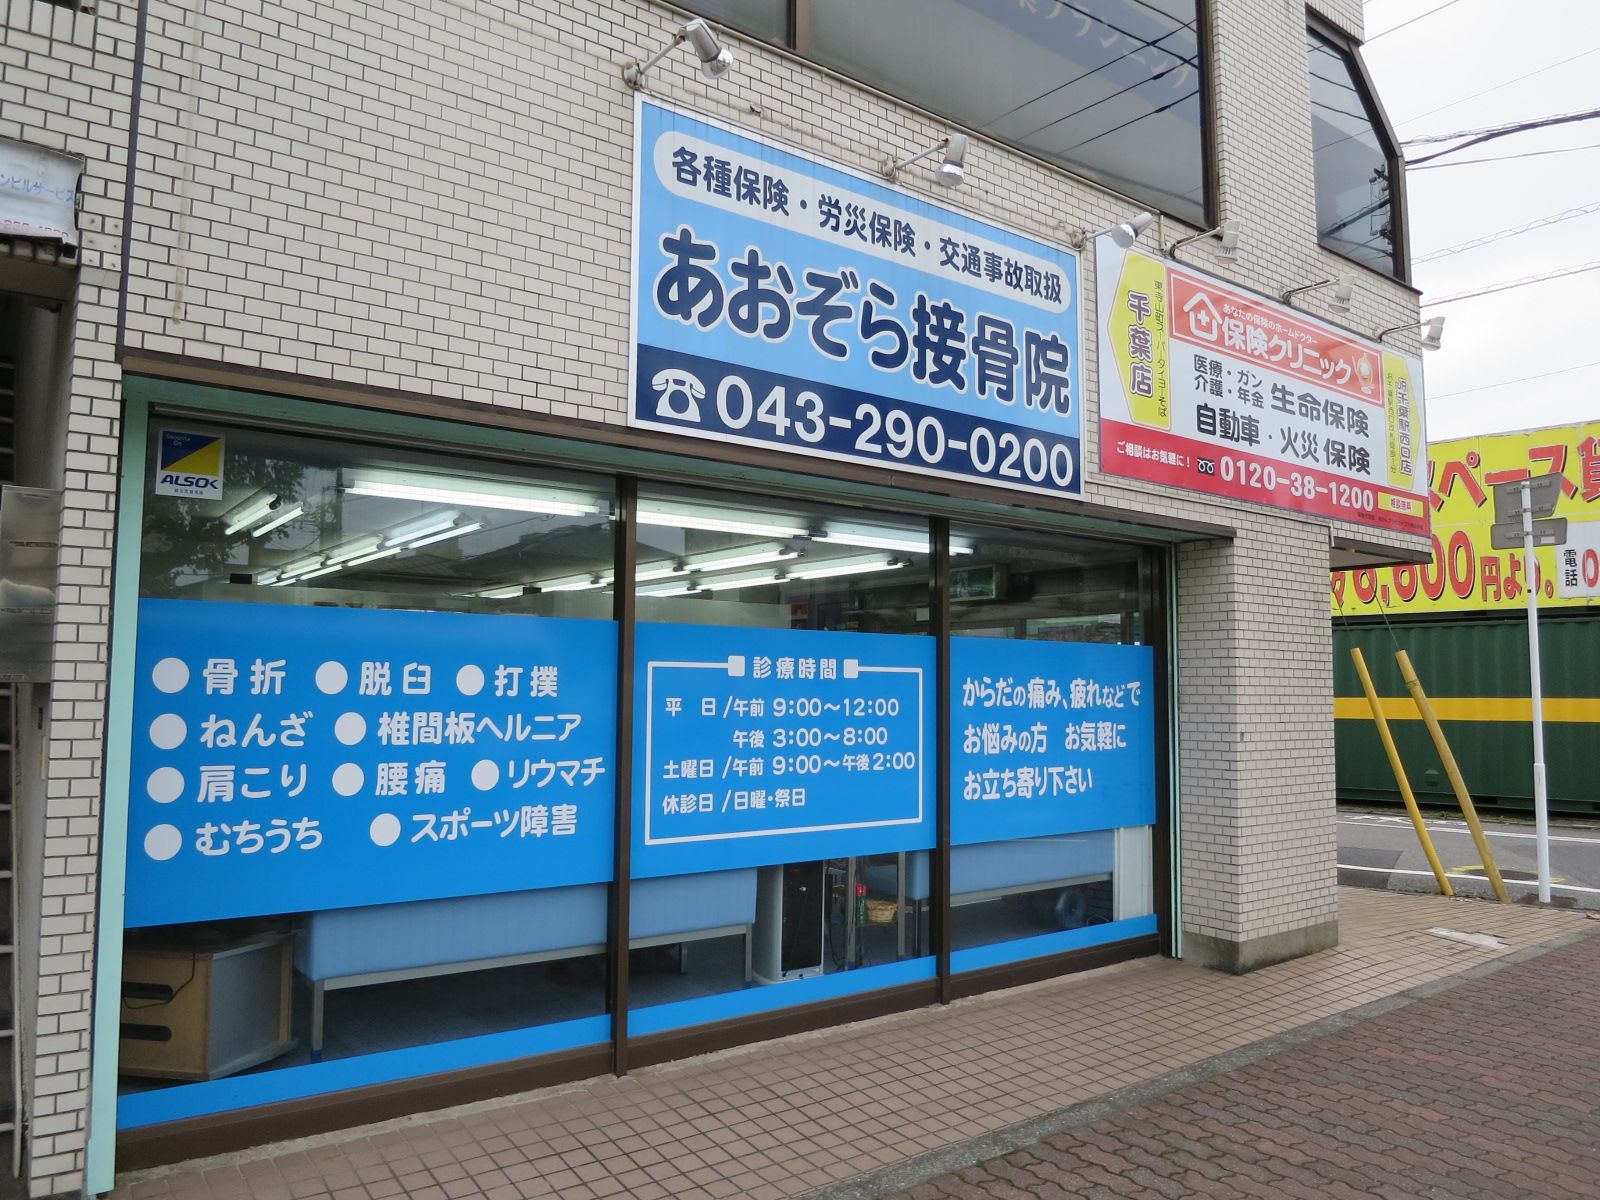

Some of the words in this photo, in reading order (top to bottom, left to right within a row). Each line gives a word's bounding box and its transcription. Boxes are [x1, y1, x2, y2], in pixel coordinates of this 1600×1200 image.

[671, 145, 1062, 304] 各種保険・労災保険・交通事故取扱
[656, 226, 1071, 416] あおぞら接骨院
[1127, 291, 1152, 398] 千葉店
[1222, 318, 1351, 385] 保険クリニック
[1193, 354, 1263, 388] 医療・ガン
[1194, 374, 1265, 409] 介護・年金
[1271, 382, 1370, 439] 生命保険
[716, 375, 1073, 487] 043-290-0200
[160, 474, 219, 489] ALSOK
[1220, 456, 1373, 512] 0120-38-1200
[1563, 549, 1579, 588] 電話
[202, 658, 287, 696] 骨折
[359, 661, 432, 697] 脱臼
[493, 664, 559, 698] 打撲
[752, 655, 837, 681] 診療時間
[962, 676, 1141, 709] からだの痛み、疲れなどで
[200, 710, 314, 748] ねんざ
[377, 711, 582, 747] 椎間板ヘルニア
[962, 721, 1048, 756] お悩みの方
[1064, 720, 1127, 752] お気軽に
[197, 763, 308, 802] 肩こり
[374, 760, 448, 797] 腰痛
[507, 756, 606, 790] リウマチ
[962, 764, 1093, 801] お立ち寄り下さい
[195, 817, 323, 857] むちうち
[410, 803, 579, 843] スポーツ障害
